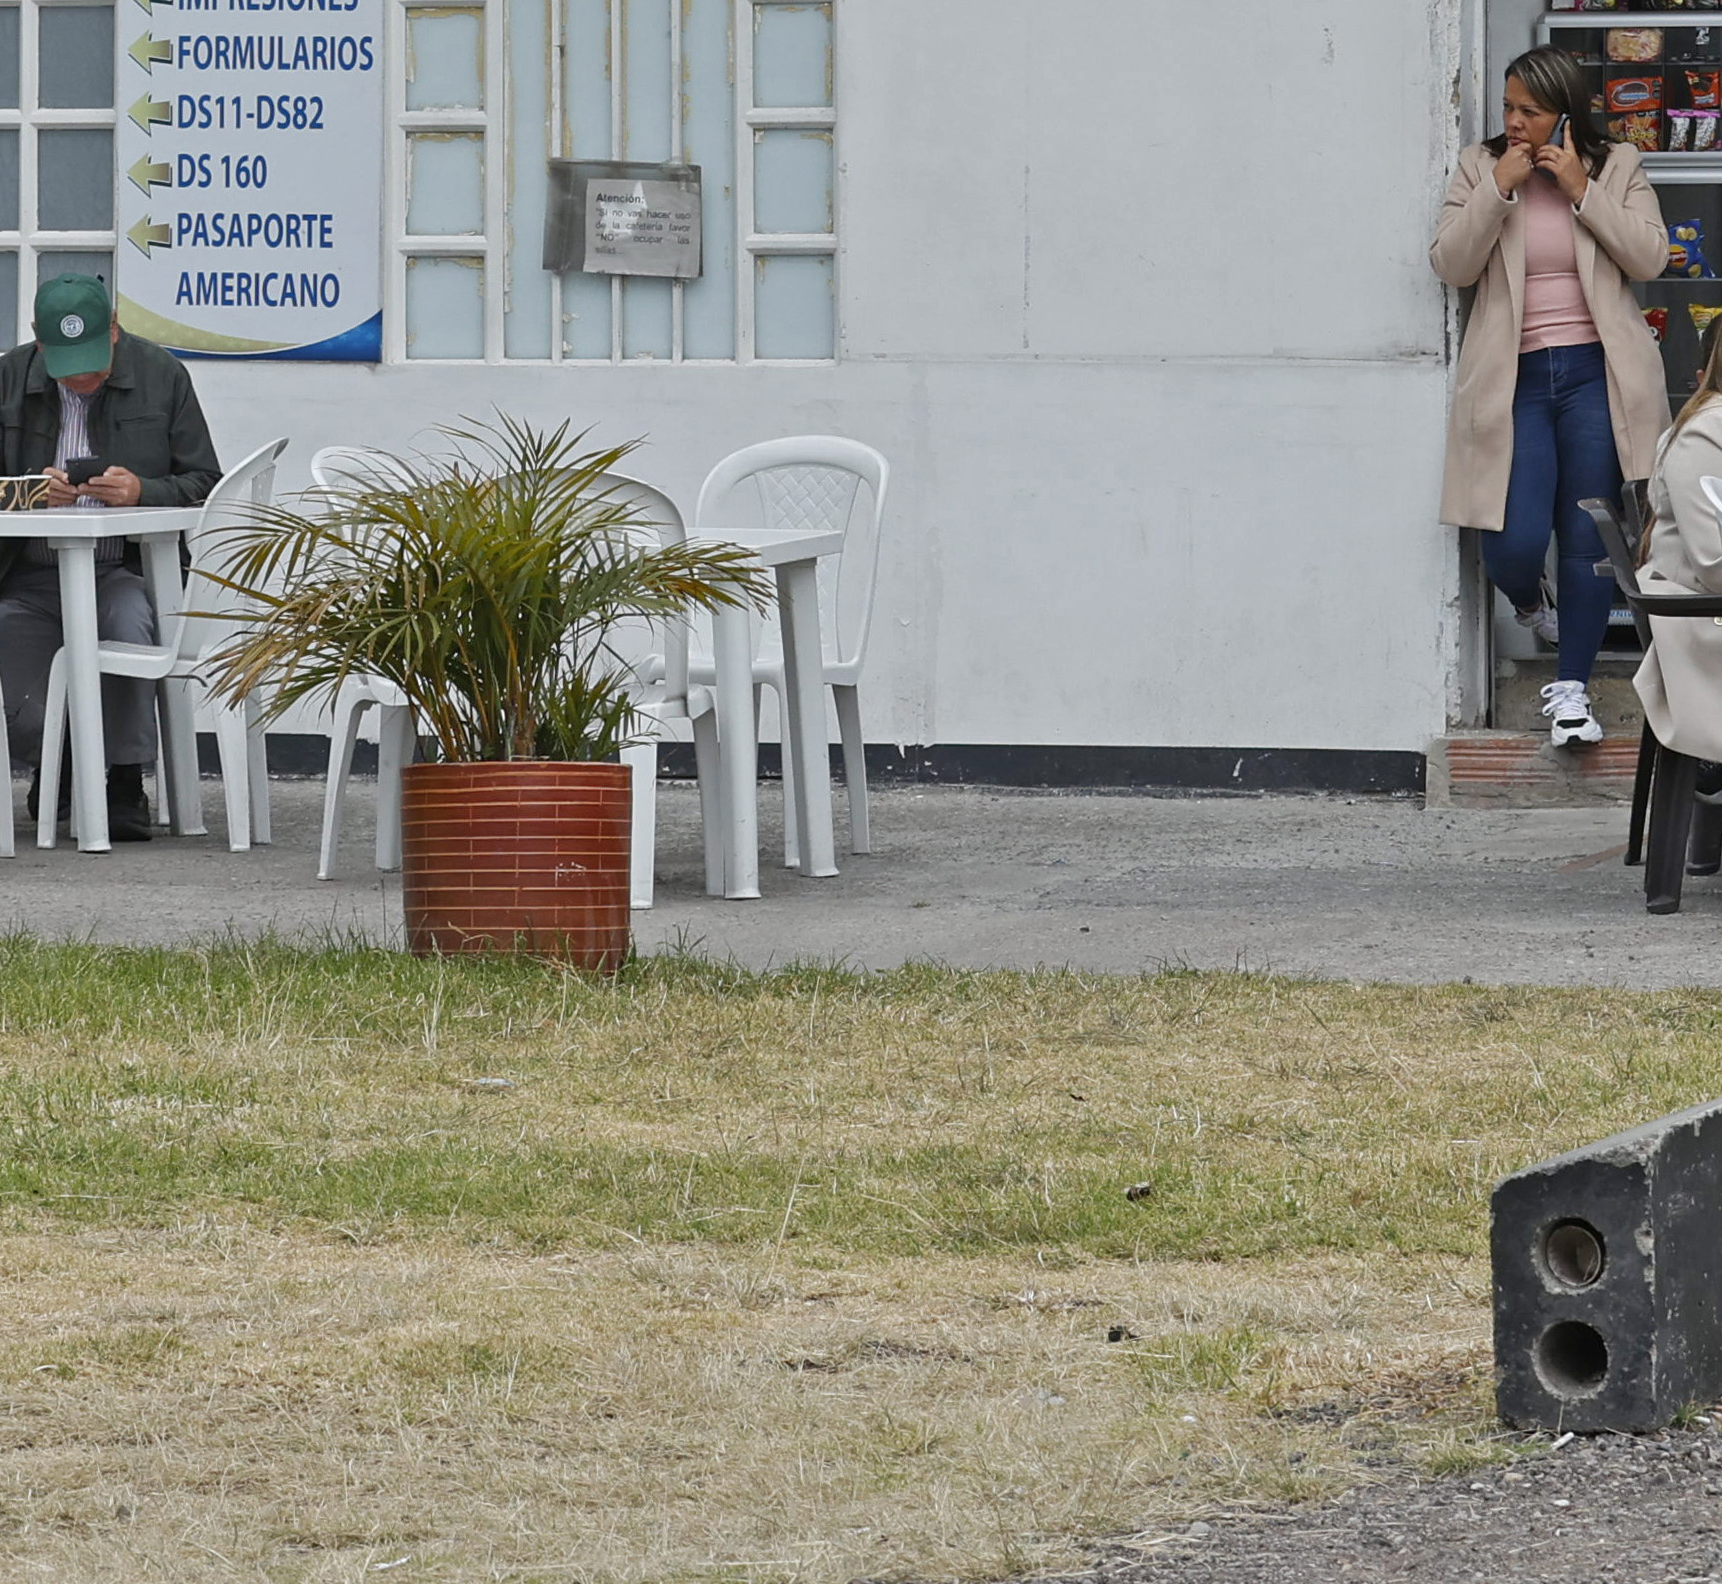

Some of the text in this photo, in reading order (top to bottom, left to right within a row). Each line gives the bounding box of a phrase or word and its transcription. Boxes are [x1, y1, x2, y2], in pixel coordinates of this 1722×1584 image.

[178, 35, 374, 72] FORMULARIOS
[177, 94, 324, 130] DS11-DS82
[177, 153, 268, 189] DS 160
[177, 212, 333, 249] PASAPORTE
[595, 221, 606, 230] de
[612, 221, 620, 229] la
[669, 223, 691, 232] favor
[612, 209, 624, 217] no
[628, 210, 642, 218] vas
[646, 209, 671, 219] hacer
[633, 235, 663, 244] ocupar
[677, 235, 690, 245] las
[175, 271, 340, 308] AMERICANO
